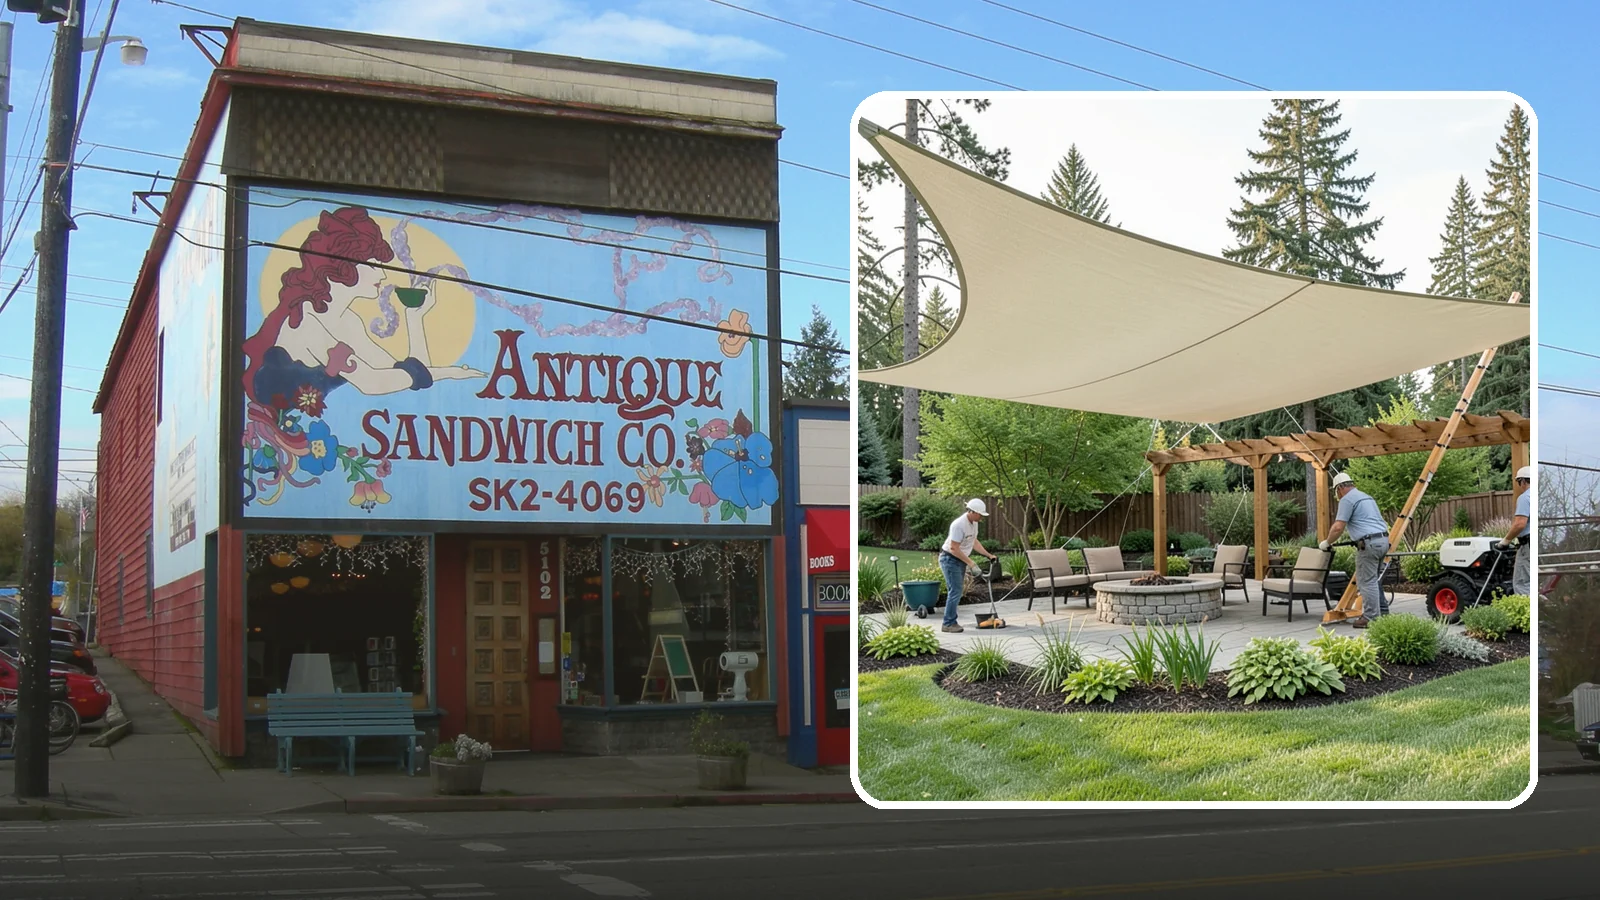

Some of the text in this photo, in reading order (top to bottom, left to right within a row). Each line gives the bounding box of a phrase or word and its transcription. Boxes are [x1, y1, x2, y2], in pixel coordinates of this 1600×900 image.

[476, 330, 723, 420] ANTIQUE
[361, 409, 685, 469] SANDWICH CO.
[468, 477, 646, 513] SK2-4069
[540, 542, 551, 599] 5102
[809, 555, 835, 569] BOOKS
